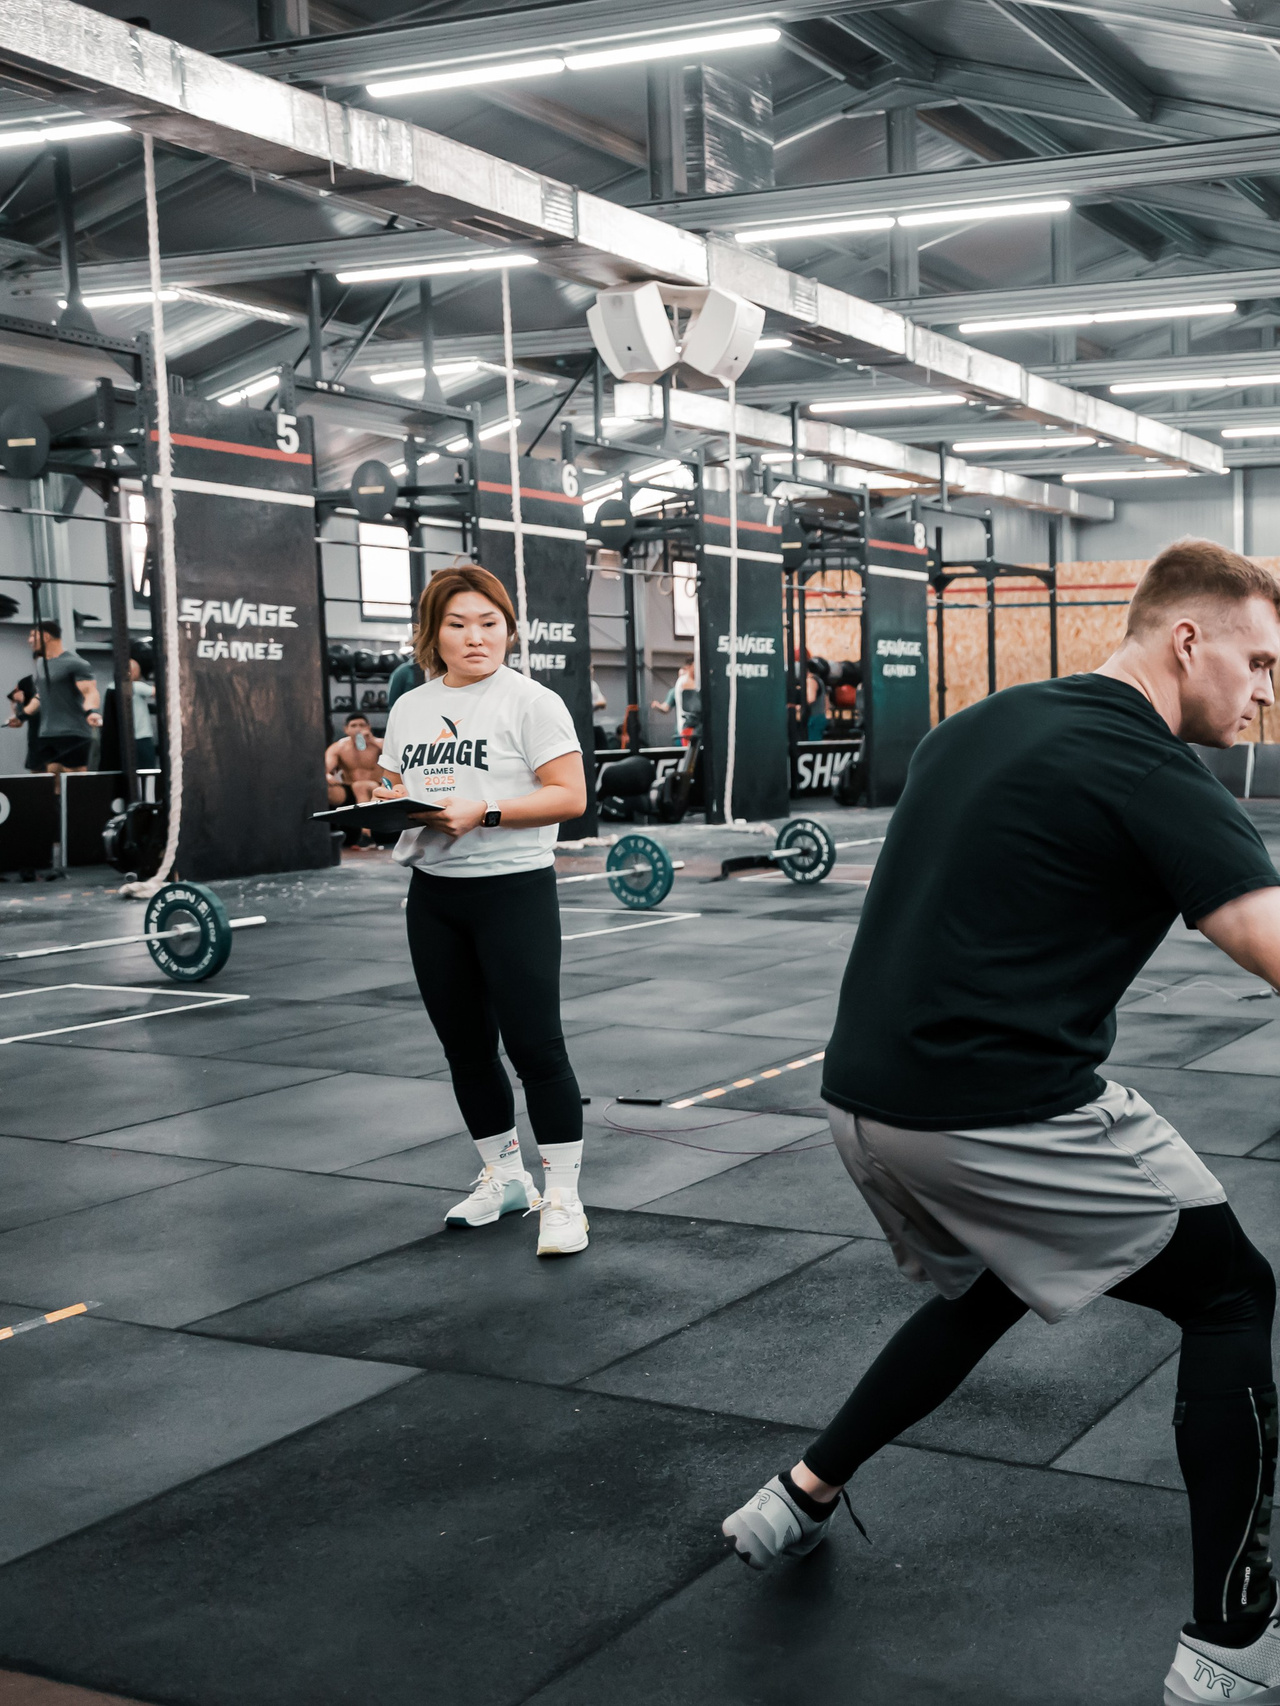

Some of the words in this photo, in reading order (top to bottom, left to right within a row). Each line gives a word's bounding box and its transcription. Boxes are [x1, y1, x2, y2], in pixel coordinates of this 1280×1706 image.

[276, 413, 300, 454] 5
[562, 463, 578, 498] 6
[763, 497, 776, 527] 7
[914, 522, 926, 549] 8
[178, 598, 299, 629] SAVAGE
[516, 618, 576, 643] VAGE
[197, 640, 285, 662] GAMES
[876, 638, 922, 657] SAVAGE
[401, 739, 489, 775] SAVAGE
[423, 767, 454, 776] GAMES
[424, 776, 455, 786] 2025
[1193, 1658, 1237, 1699] TYR
